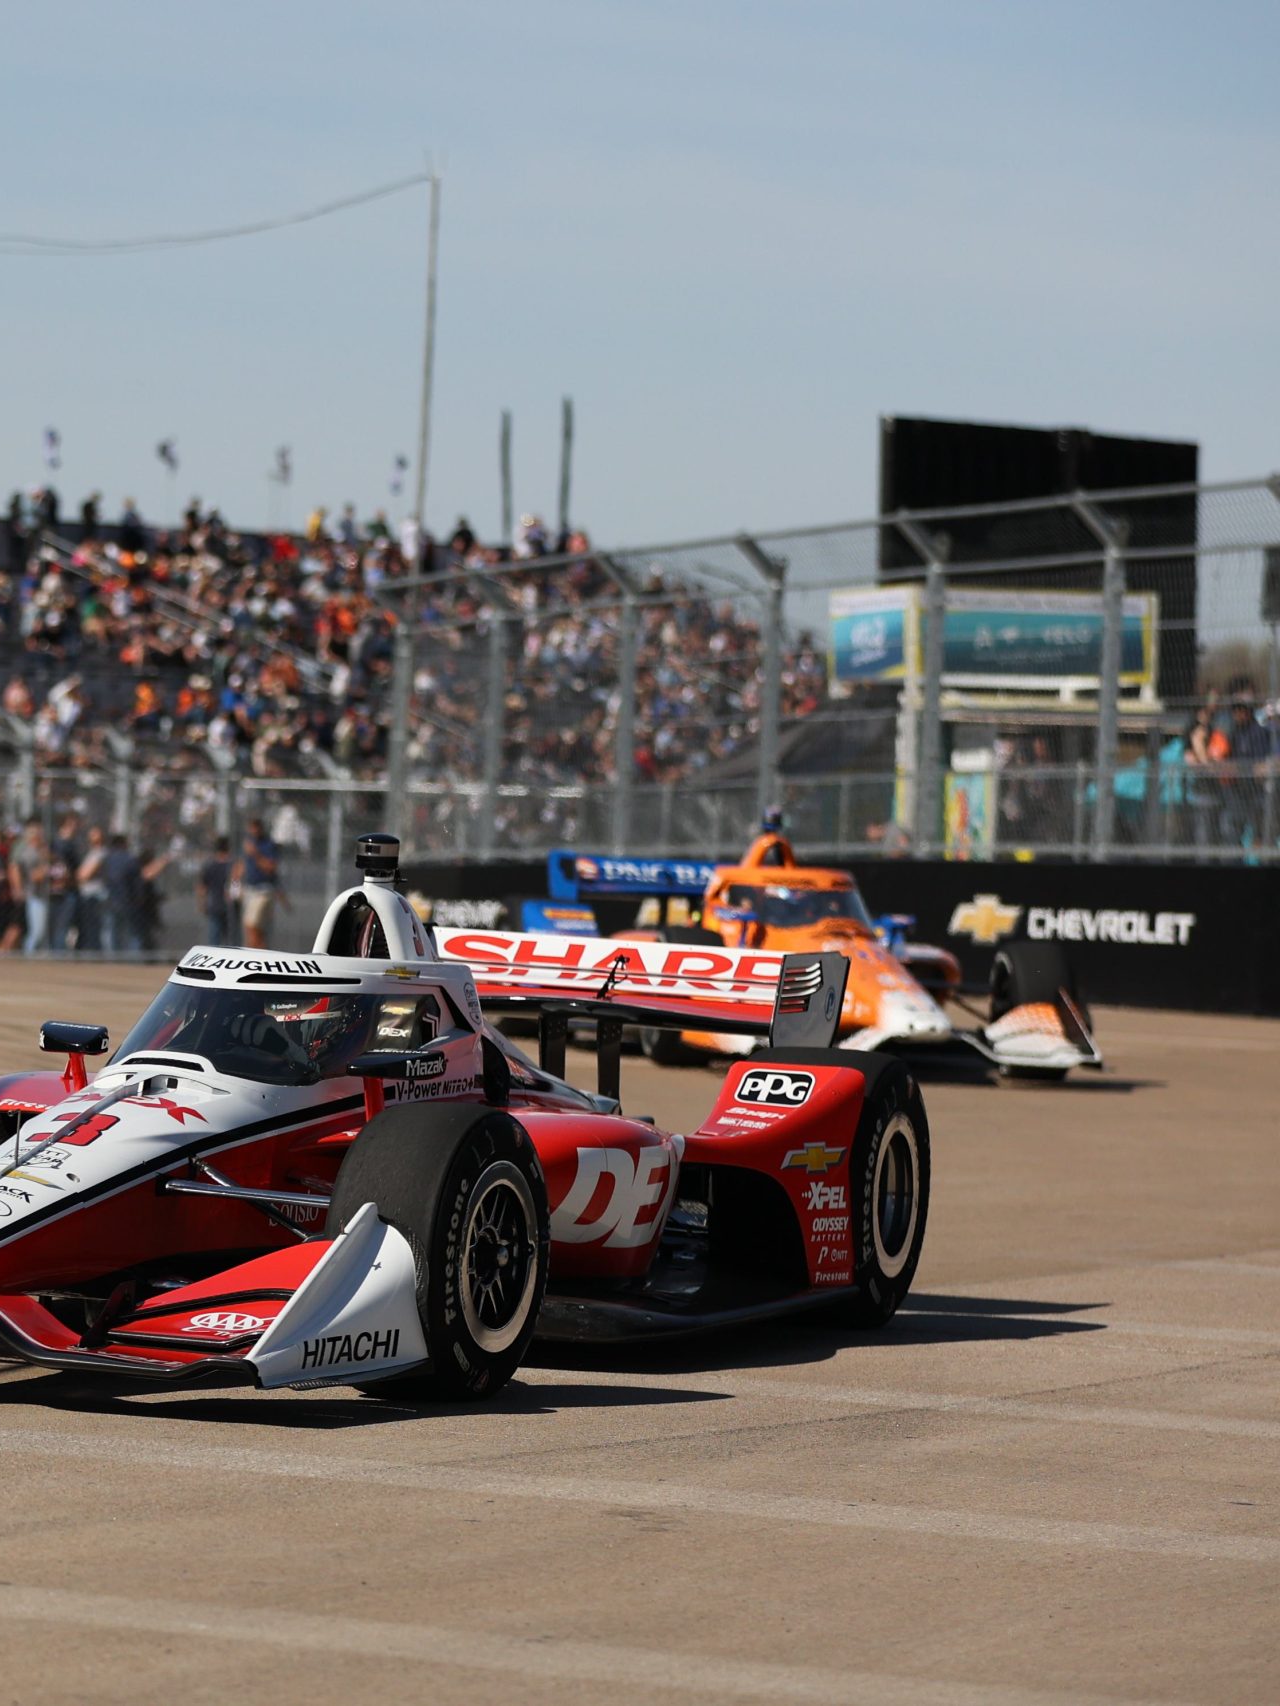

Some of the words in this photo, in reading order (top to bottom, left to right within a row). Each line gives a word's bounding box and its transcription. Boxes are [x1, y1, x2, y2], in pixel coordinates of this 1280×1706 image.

[1027, 907, 1195, 945] CHEVROLET
[184, 952, 323, 975] MCLAUGHLIN
[444, 934, 783, 993] SHARP
[378, 1027, 410, 1038] DEX
[405, 1057, 445, 1077] Mazak
[396, 1080, 442, 1102] V-Power
[740, 1074, 809, 1102] PPG
[25, 1112, 121, 1147] 3
[807, 1181, 847, 1210] XPEL
[862, 1118, 883, 1263] Firestone
[812, 1217, 849, 1232] ODYSSEY
[811, 1233, 846, 1243] BATTERY
[444, 1177, 470, 1326] Firestone
[815, 1271, 849, 1283] Firestone
[191, 1312, 264, 1331] AAA
[301, 1328, 401, 1370] HITACHI
